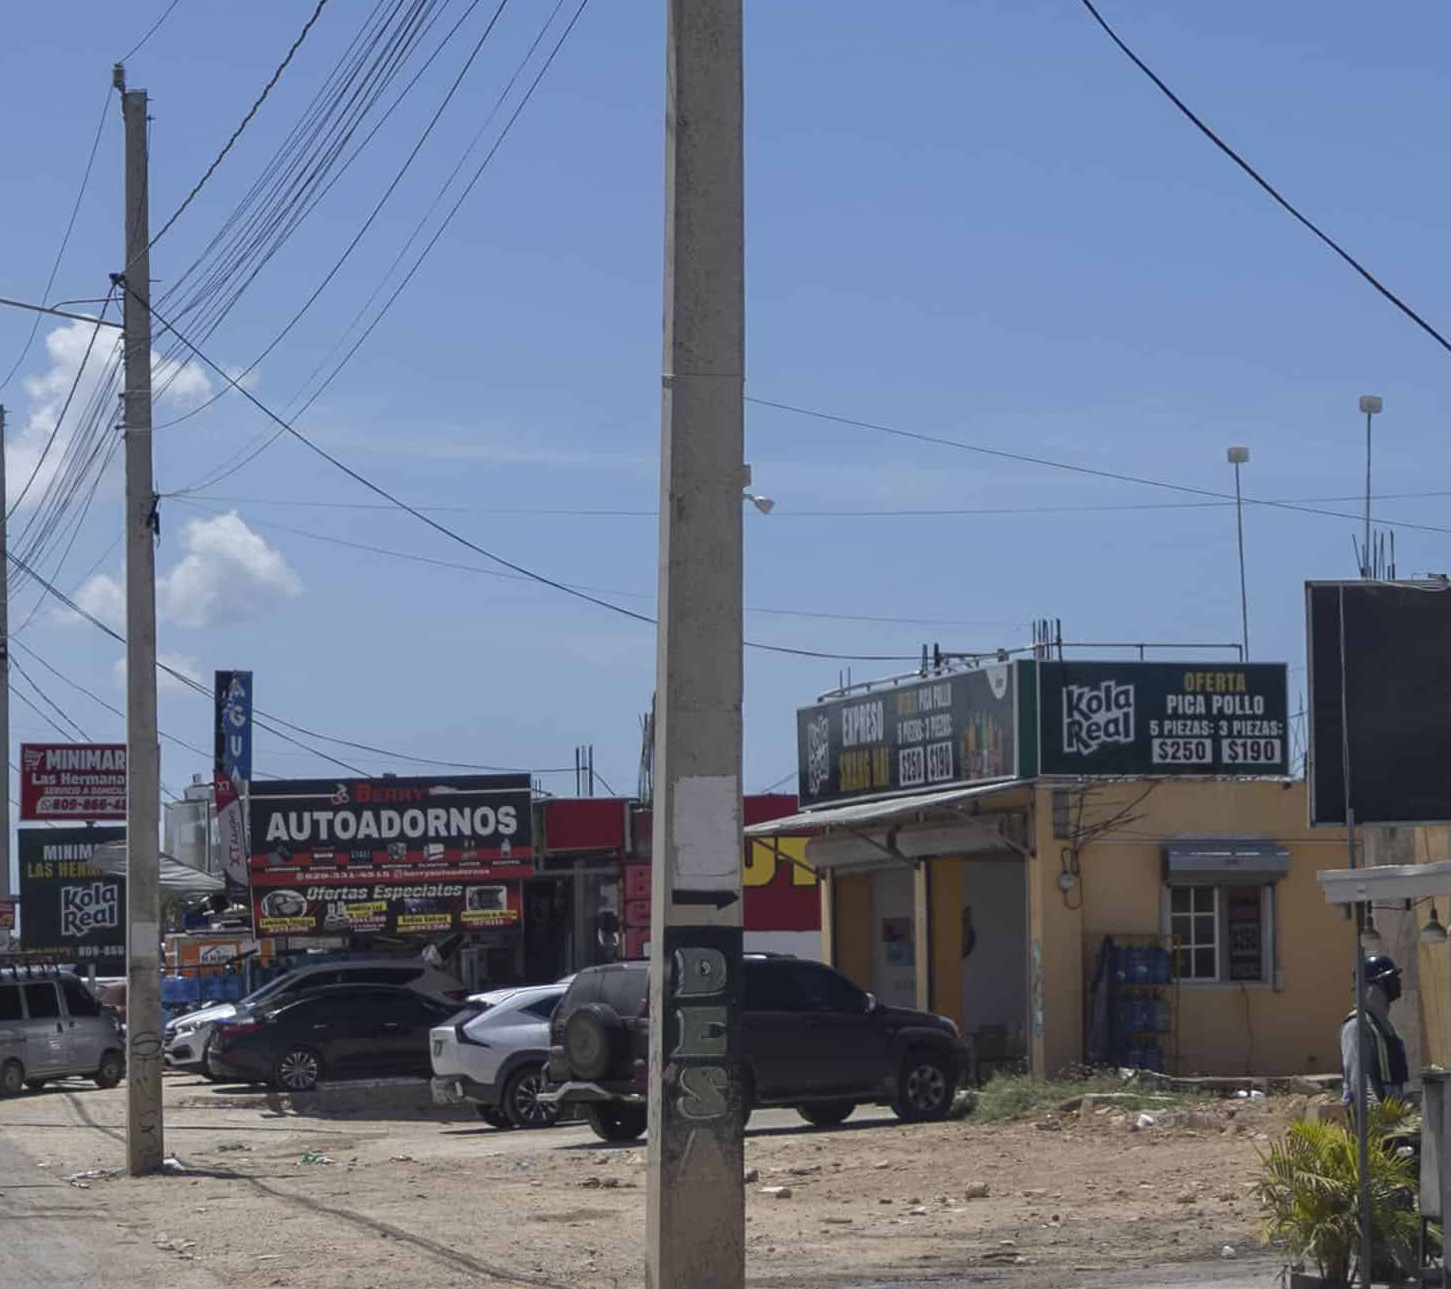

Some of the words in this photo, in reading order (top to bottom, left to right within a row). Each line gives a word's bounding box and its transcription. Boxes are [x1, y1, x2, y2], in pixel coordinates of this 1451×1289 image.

[1183, 672, 1246, 692] OFERTA
[1062, 680, 1135, 721] Kola
[1166, 695, 1206, 715] PICA
[1212, 695, 1265, 715] POLLO
[841, 701, 884, 748] EXPRESO
[1062, 712, 1135, 756] Real
[1149, 721, 1159, 736] 5
[1163, 721, 1214, 736] PIEZAS:
[1219, 721, 1228, 736] 3
[1233, 720, 1284, 736] PIEZAS:
[1158, 740, 1207, 762] $250
[1227, 740, 1276, 762] $190
[32, 773, 57, 785] Las
[265, 805, 519, 842] AUTOADORNOS
[61, 883, 118, 912] Kola
[306, 886, 368, 901] Ofertas
[372, 882, 463, 902] Especiales
[61, 905, 118, 937] Real
